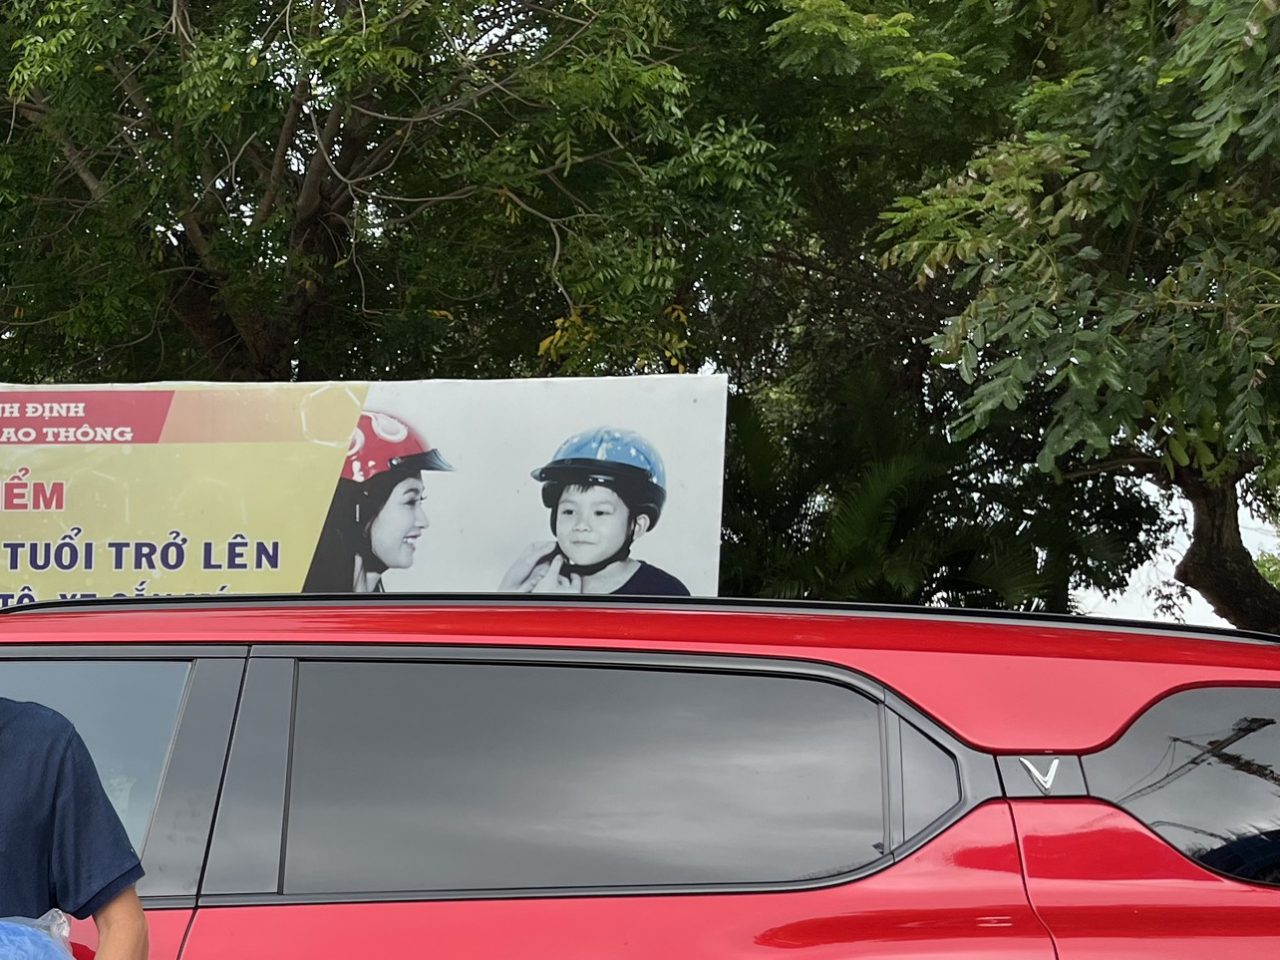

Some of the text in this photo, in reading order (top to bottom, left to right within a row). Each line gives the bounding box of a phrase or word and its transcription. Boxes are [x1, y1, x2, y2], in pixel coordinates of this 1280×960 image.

[25, 403, 85, 420] ĐỊNH
[43, 424, 133, 442] THÔNG
[3, 527, 94, 571] TUỔI
[108, 530, 188, 571] TRỞ
[202, 534, 279, 570] LÊN
